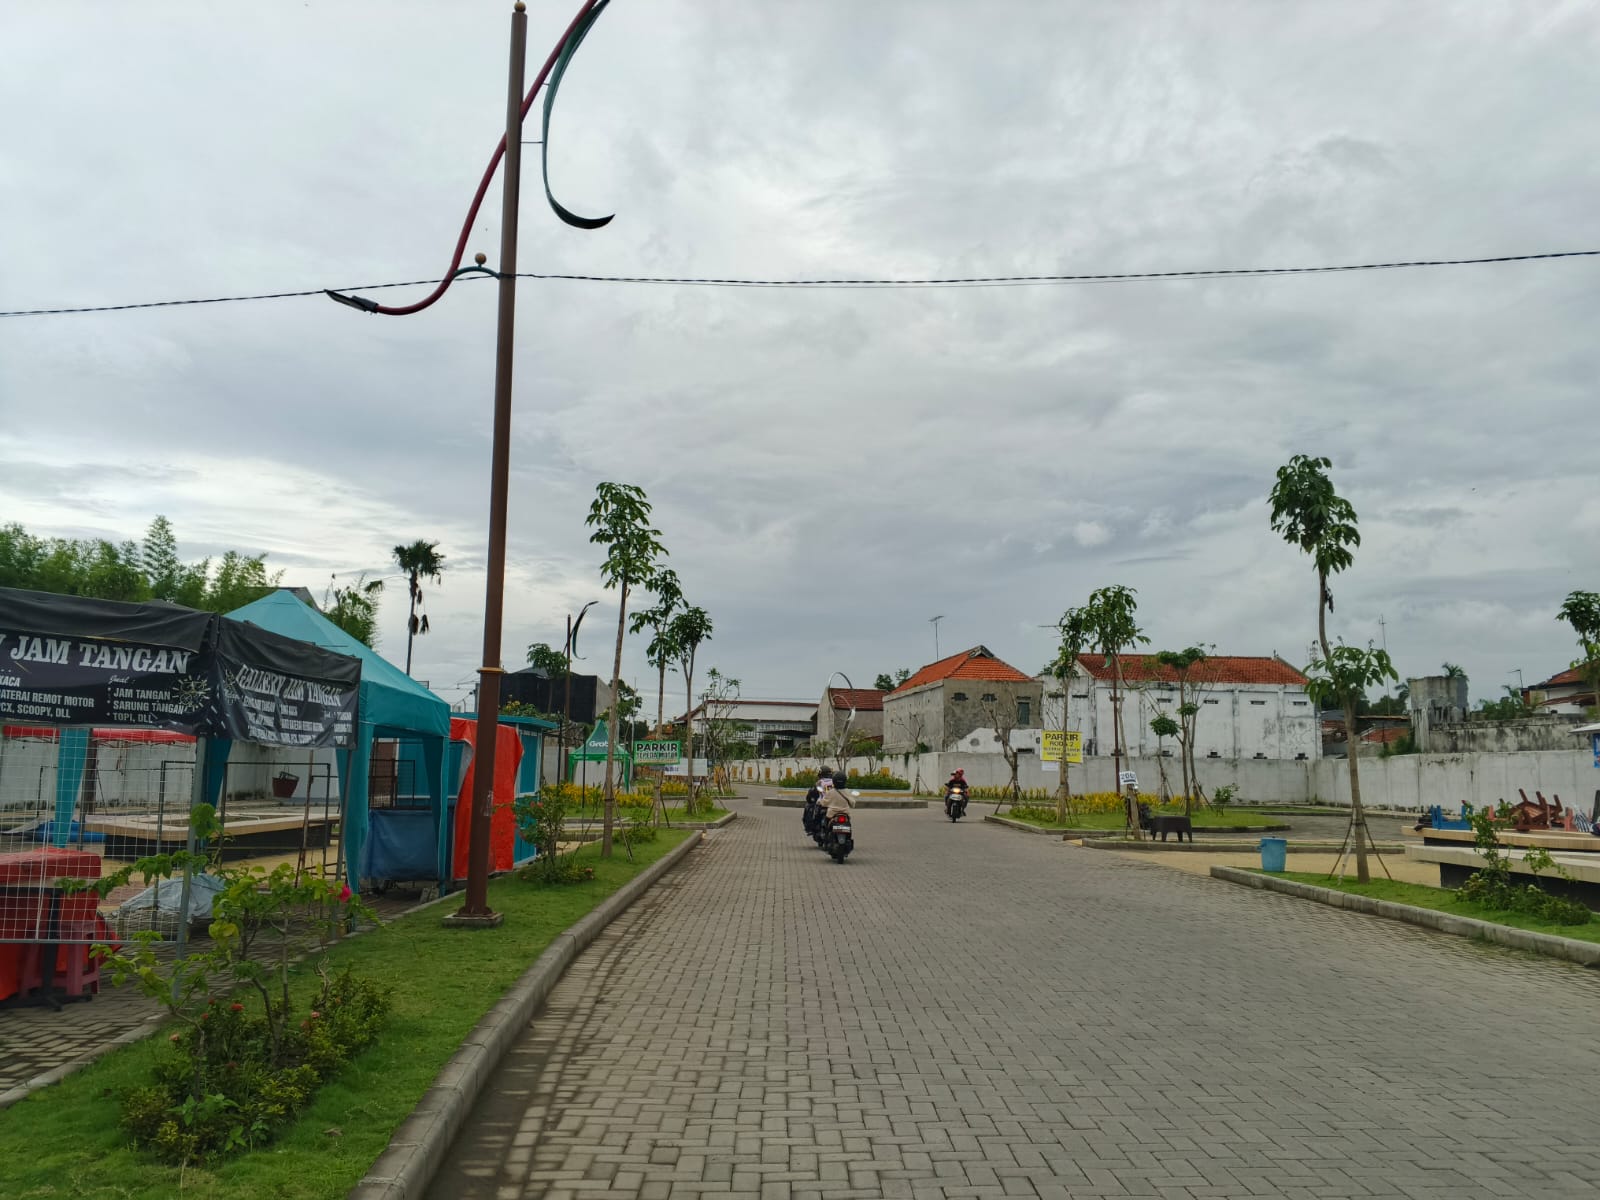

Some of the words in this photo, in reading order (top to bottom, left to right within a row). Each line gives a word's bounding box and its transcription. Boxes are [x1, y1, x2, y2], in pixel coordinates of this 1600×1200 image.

[10, 635, 71, 665] JAM
[79, 643, 191, 674] TANGAN
[236, 664, 286, 697] GALLERY
[283, 678, 306, 702] JAM
[0, 689, 30, 701] ATERAI
[32, 692, 62, 704] REMOT
[64, 695, 95, 708] MOTOR
[113, 688, 133, 699] JAM
[136, 689, 171, 700] TANGAN
[0, 702, 15, 713] CX,
[17, 704, 53, 717] SCOOPY,
[55, 708, 71, 718] DLL
[113, 700, 150, 712] SARUNG
[152, 702, 185, 715] TANGAN
[138, 713, 153, 724] DLL
[636, 743, 678, 752] PARKIR
